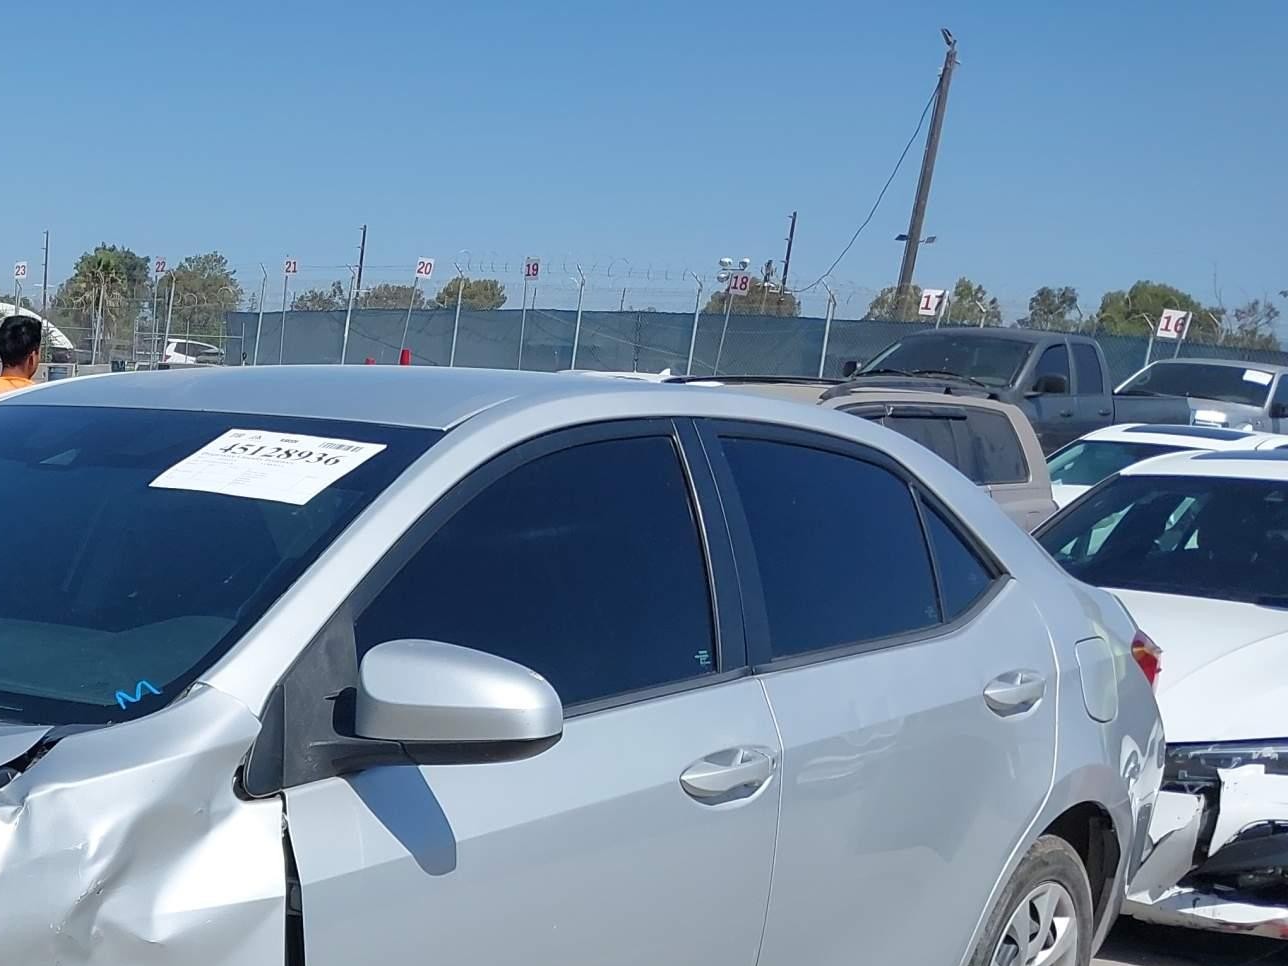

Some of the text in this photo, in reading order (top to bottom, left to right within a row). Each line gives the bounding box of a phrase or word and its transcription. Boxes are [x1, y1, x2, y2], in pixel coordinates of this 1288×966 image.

[15, 265, 26, 276] 23
[155, 261, 166, 273] 22
[285, 261, 297, 273] 21
[417, 261, 433, 275] 20
[526, 262, 539, 277] 19
[731, 275, 749, 291] 18
[921, 294, 944, 312] 17
[1160, 315, 1186, 334] 16
[219, 442, 345, 466] 45128936
